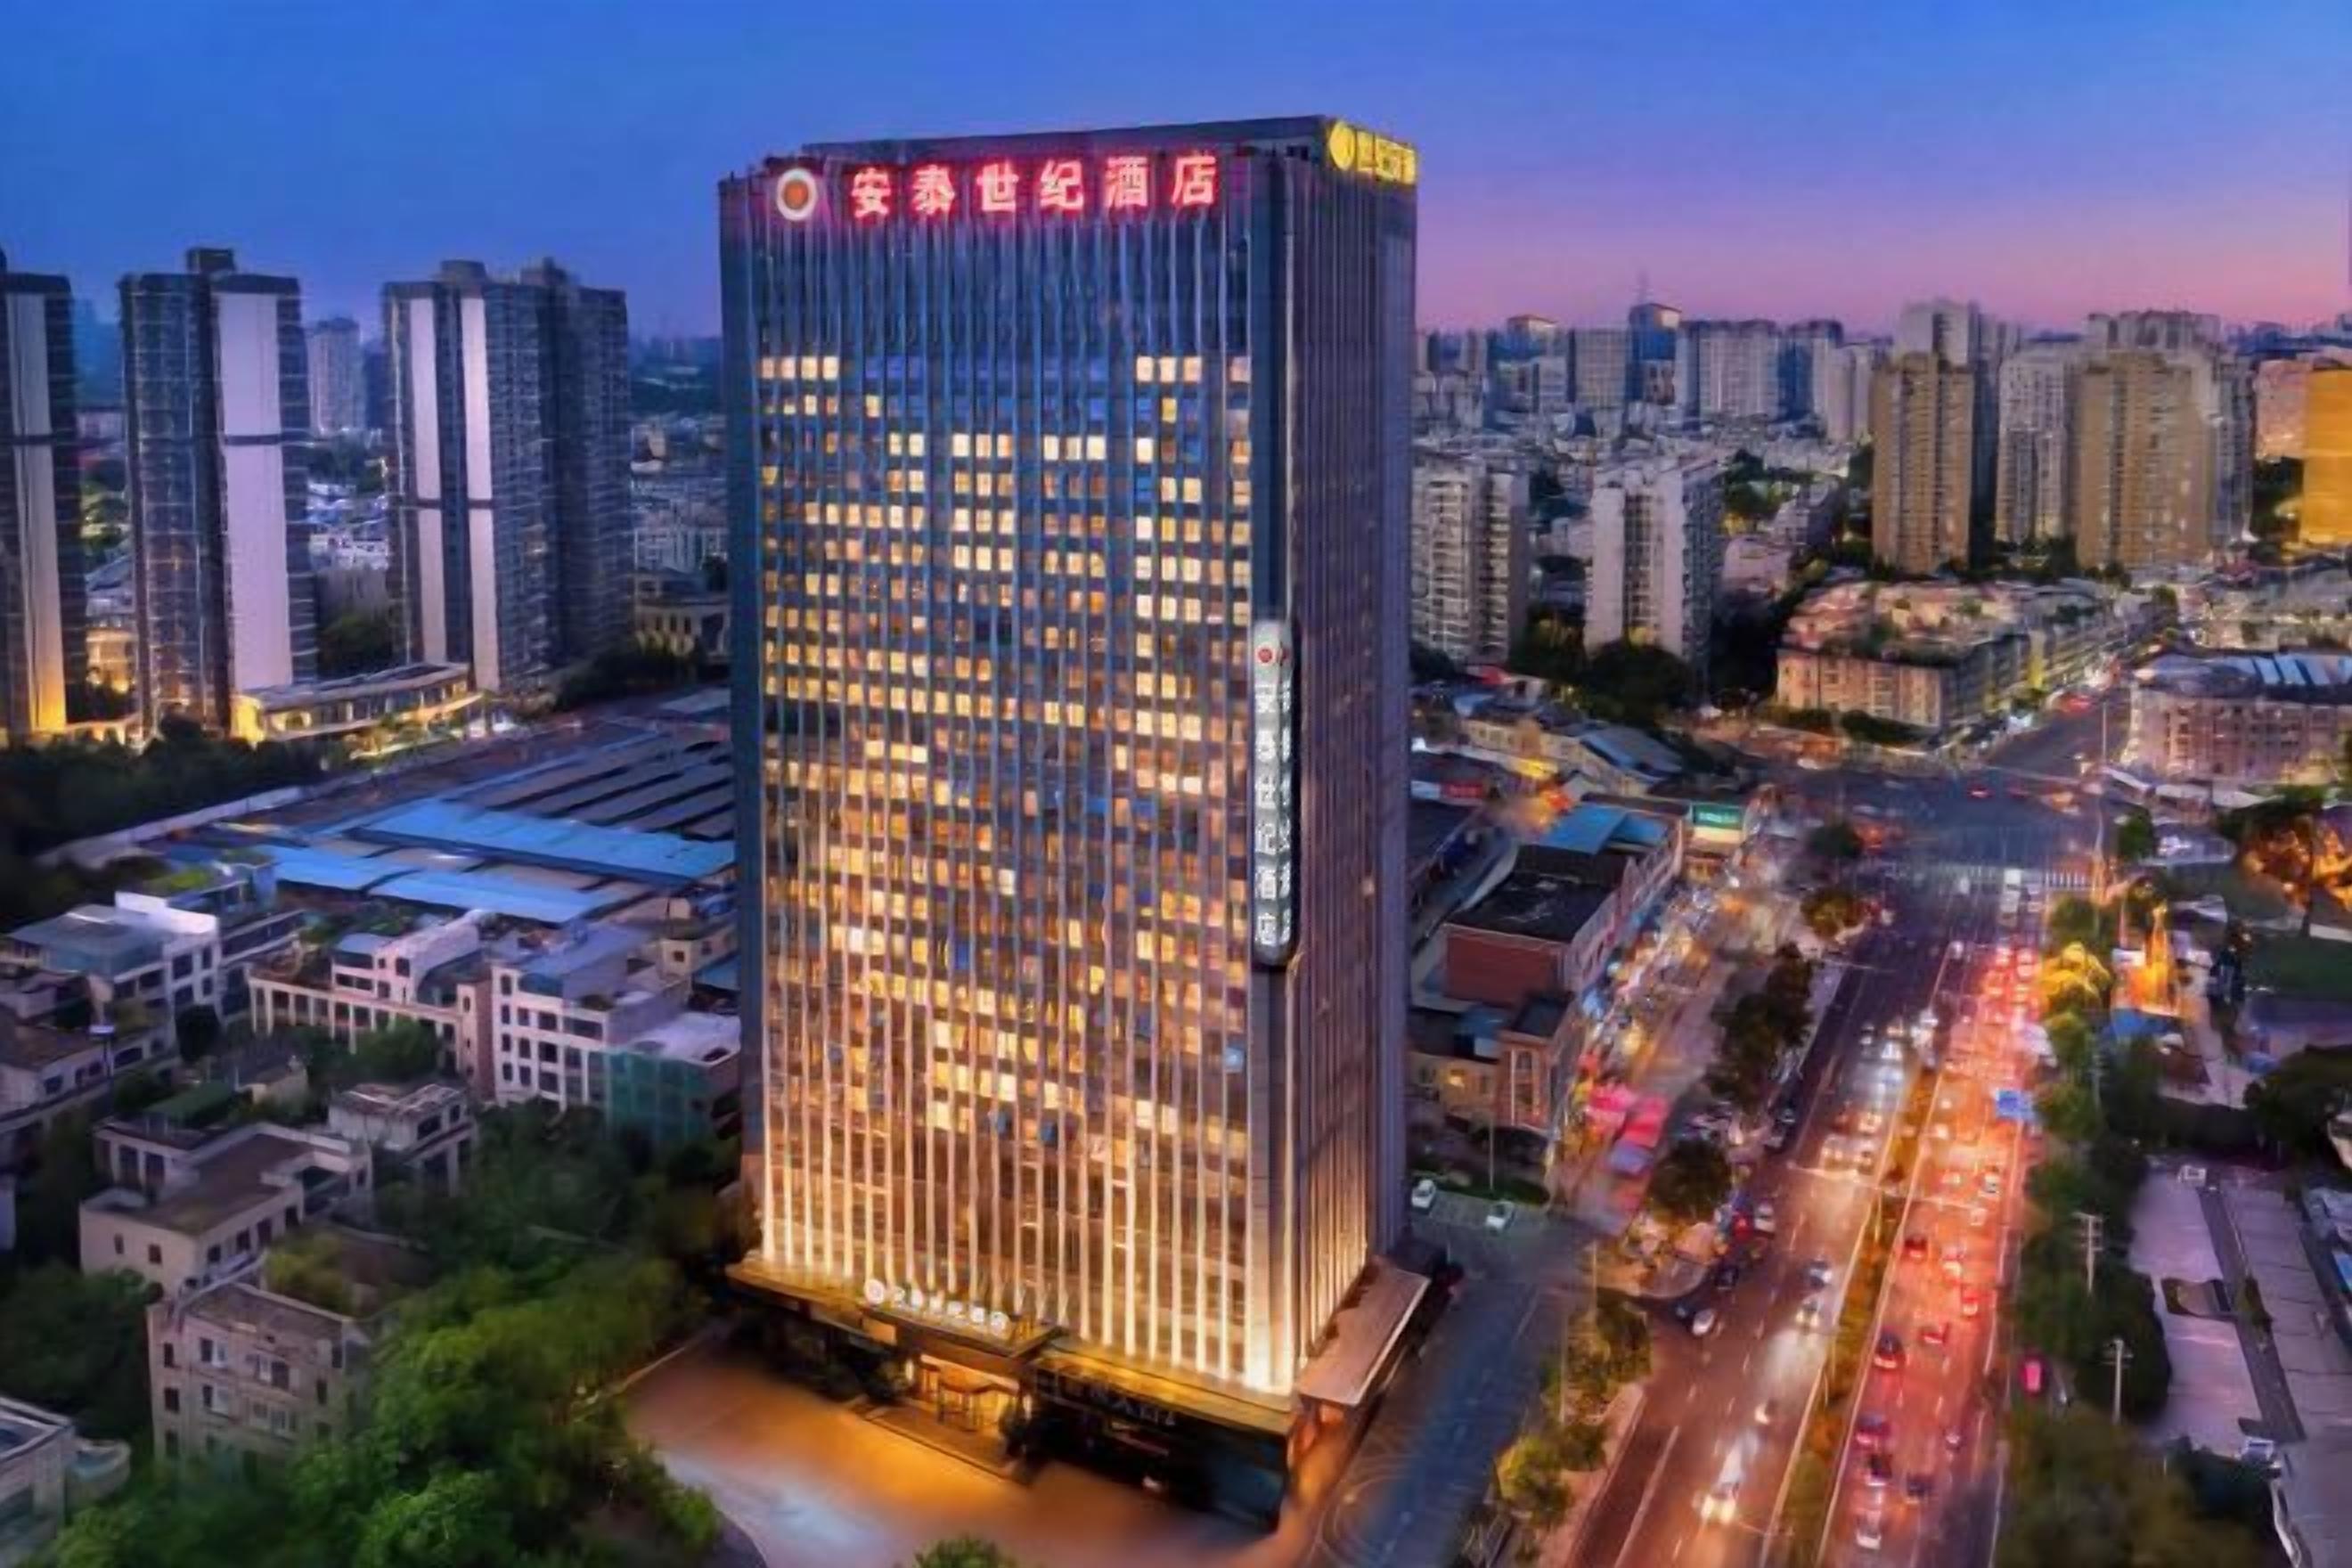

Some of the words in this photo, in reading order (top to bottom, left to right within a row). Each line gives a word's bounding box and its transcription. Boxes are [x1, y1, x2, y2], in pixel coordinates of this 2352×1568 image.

[851, 152, 1215, 218] 安泰世纪酒店
